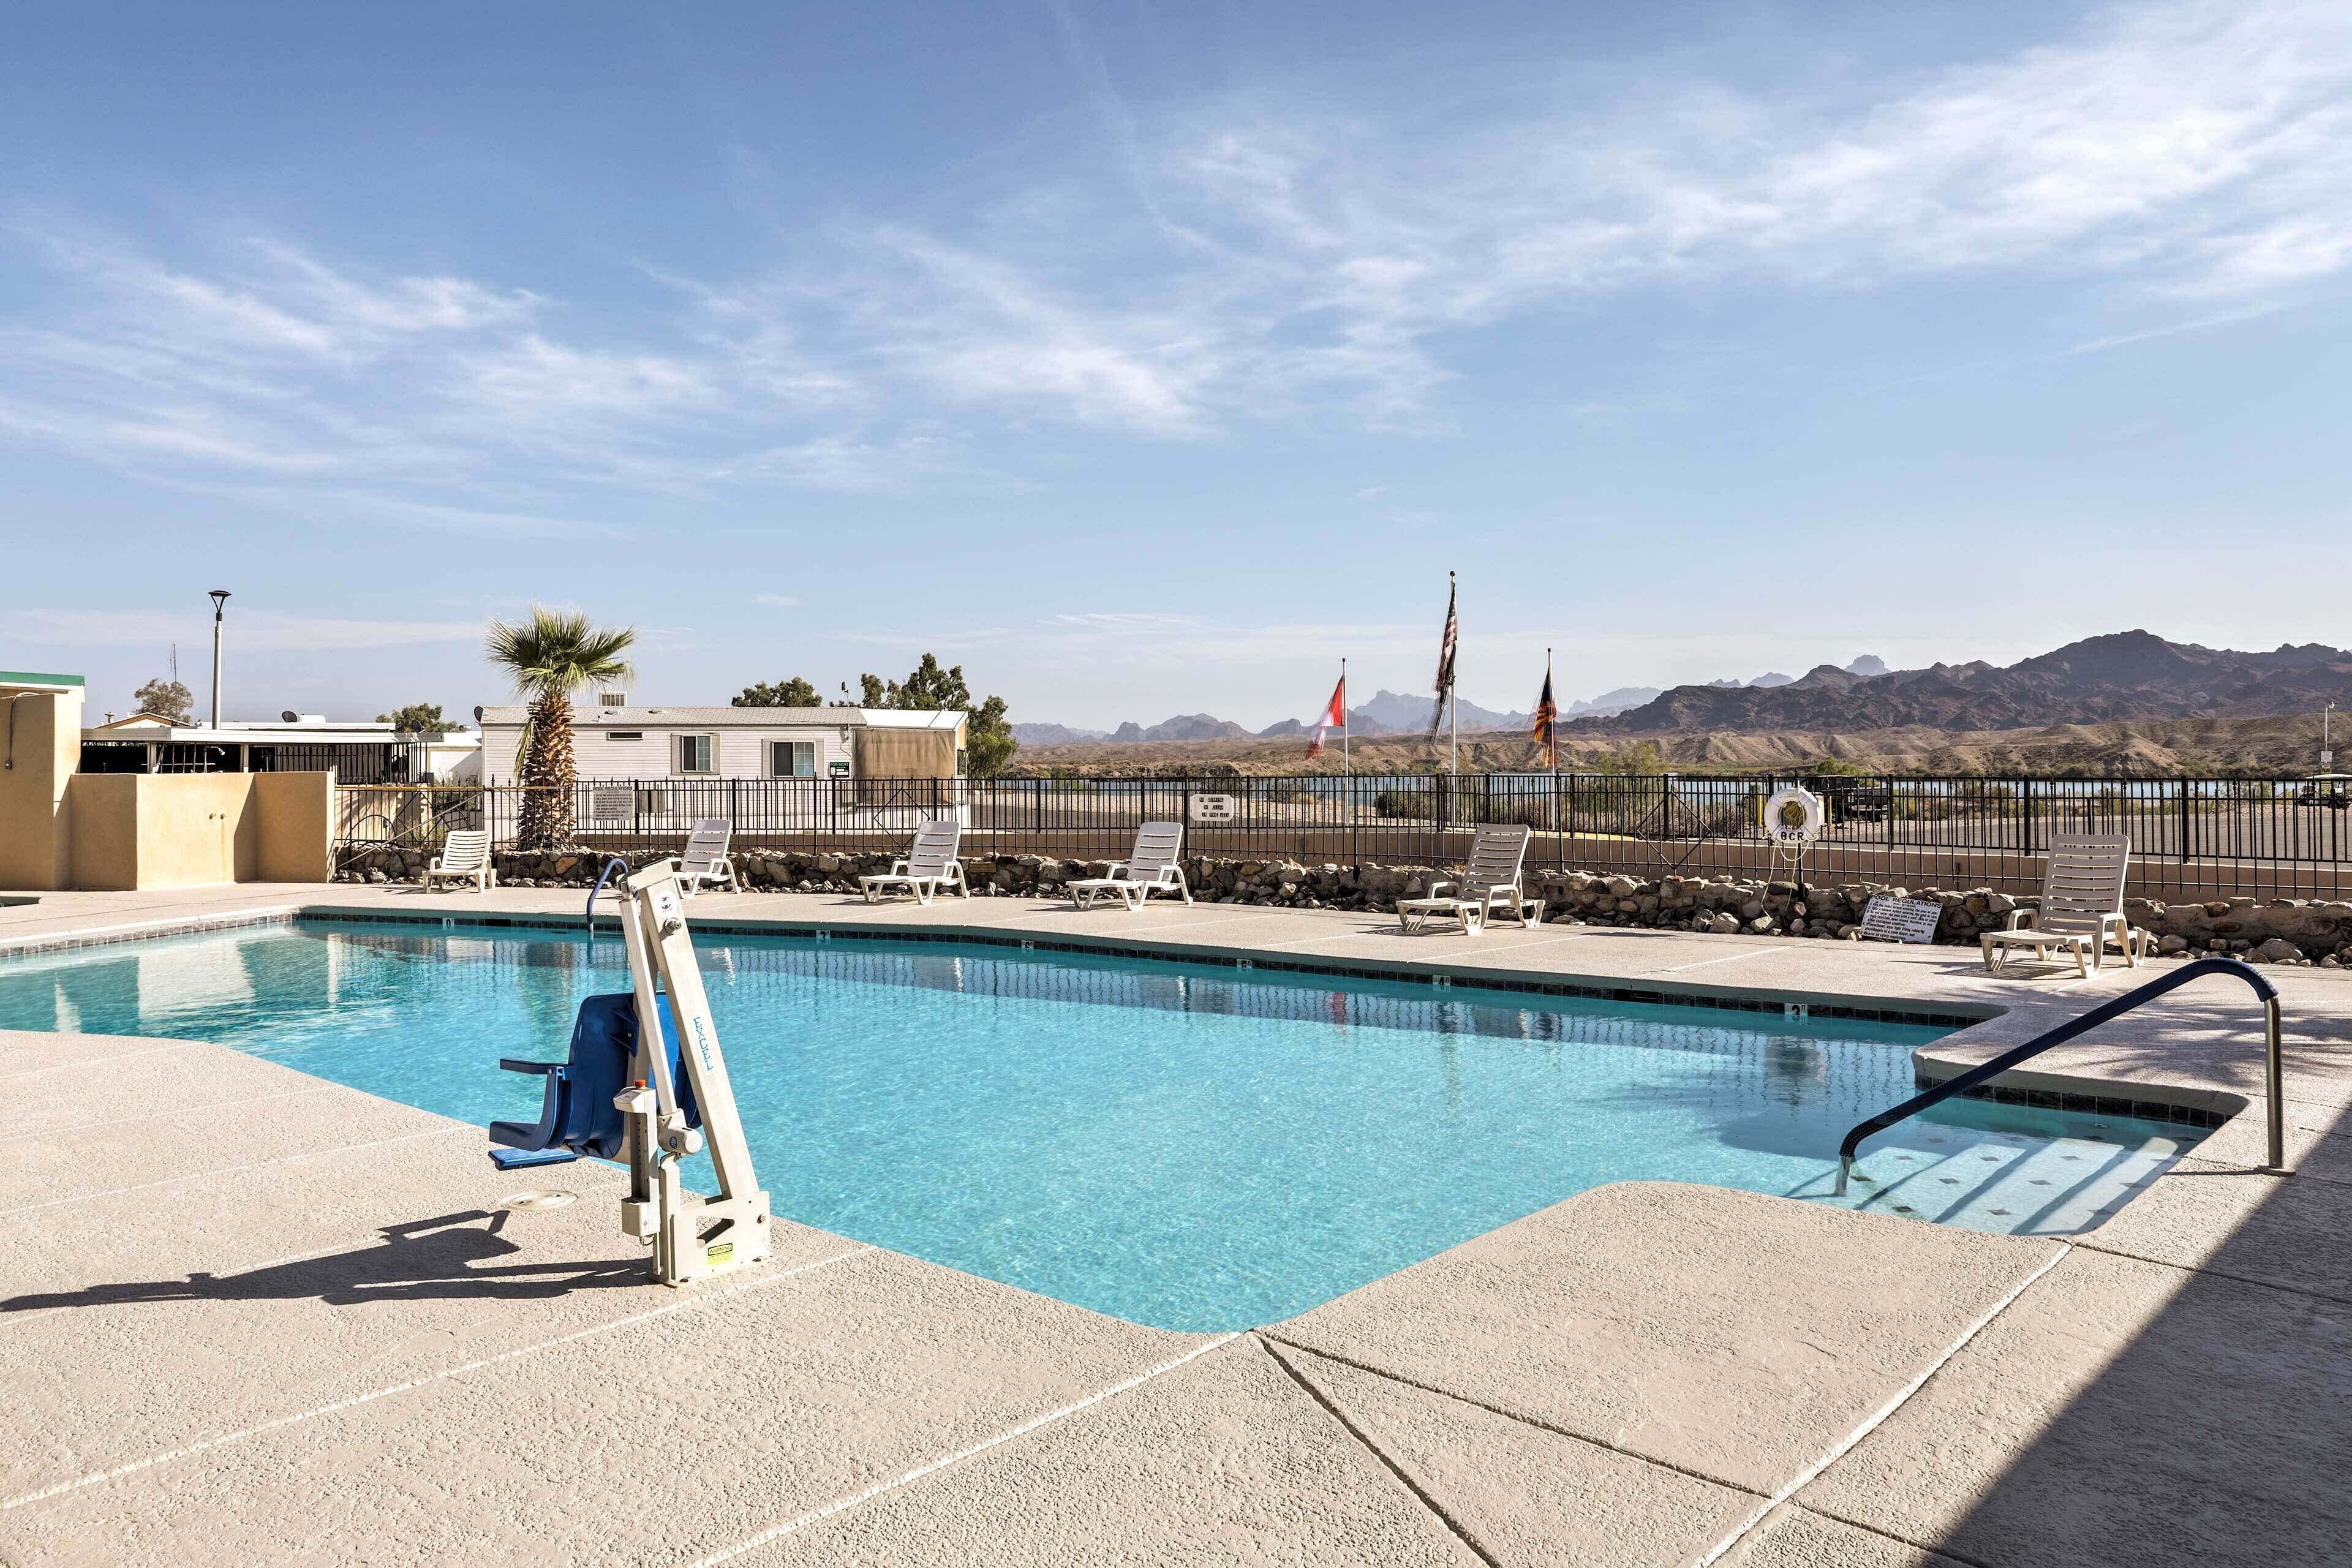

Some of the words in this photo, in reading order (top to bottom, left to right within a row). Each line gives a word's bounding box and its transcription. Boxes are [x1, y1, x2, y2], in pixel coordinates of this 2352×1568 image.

[1781, 832, 1804, 840] BCR
[1892, 897, 1942, 908] REGULATIONS
[693, 1017, 714, 1071] EXCEL
[709, 1245, 732, 1254] WARNING
